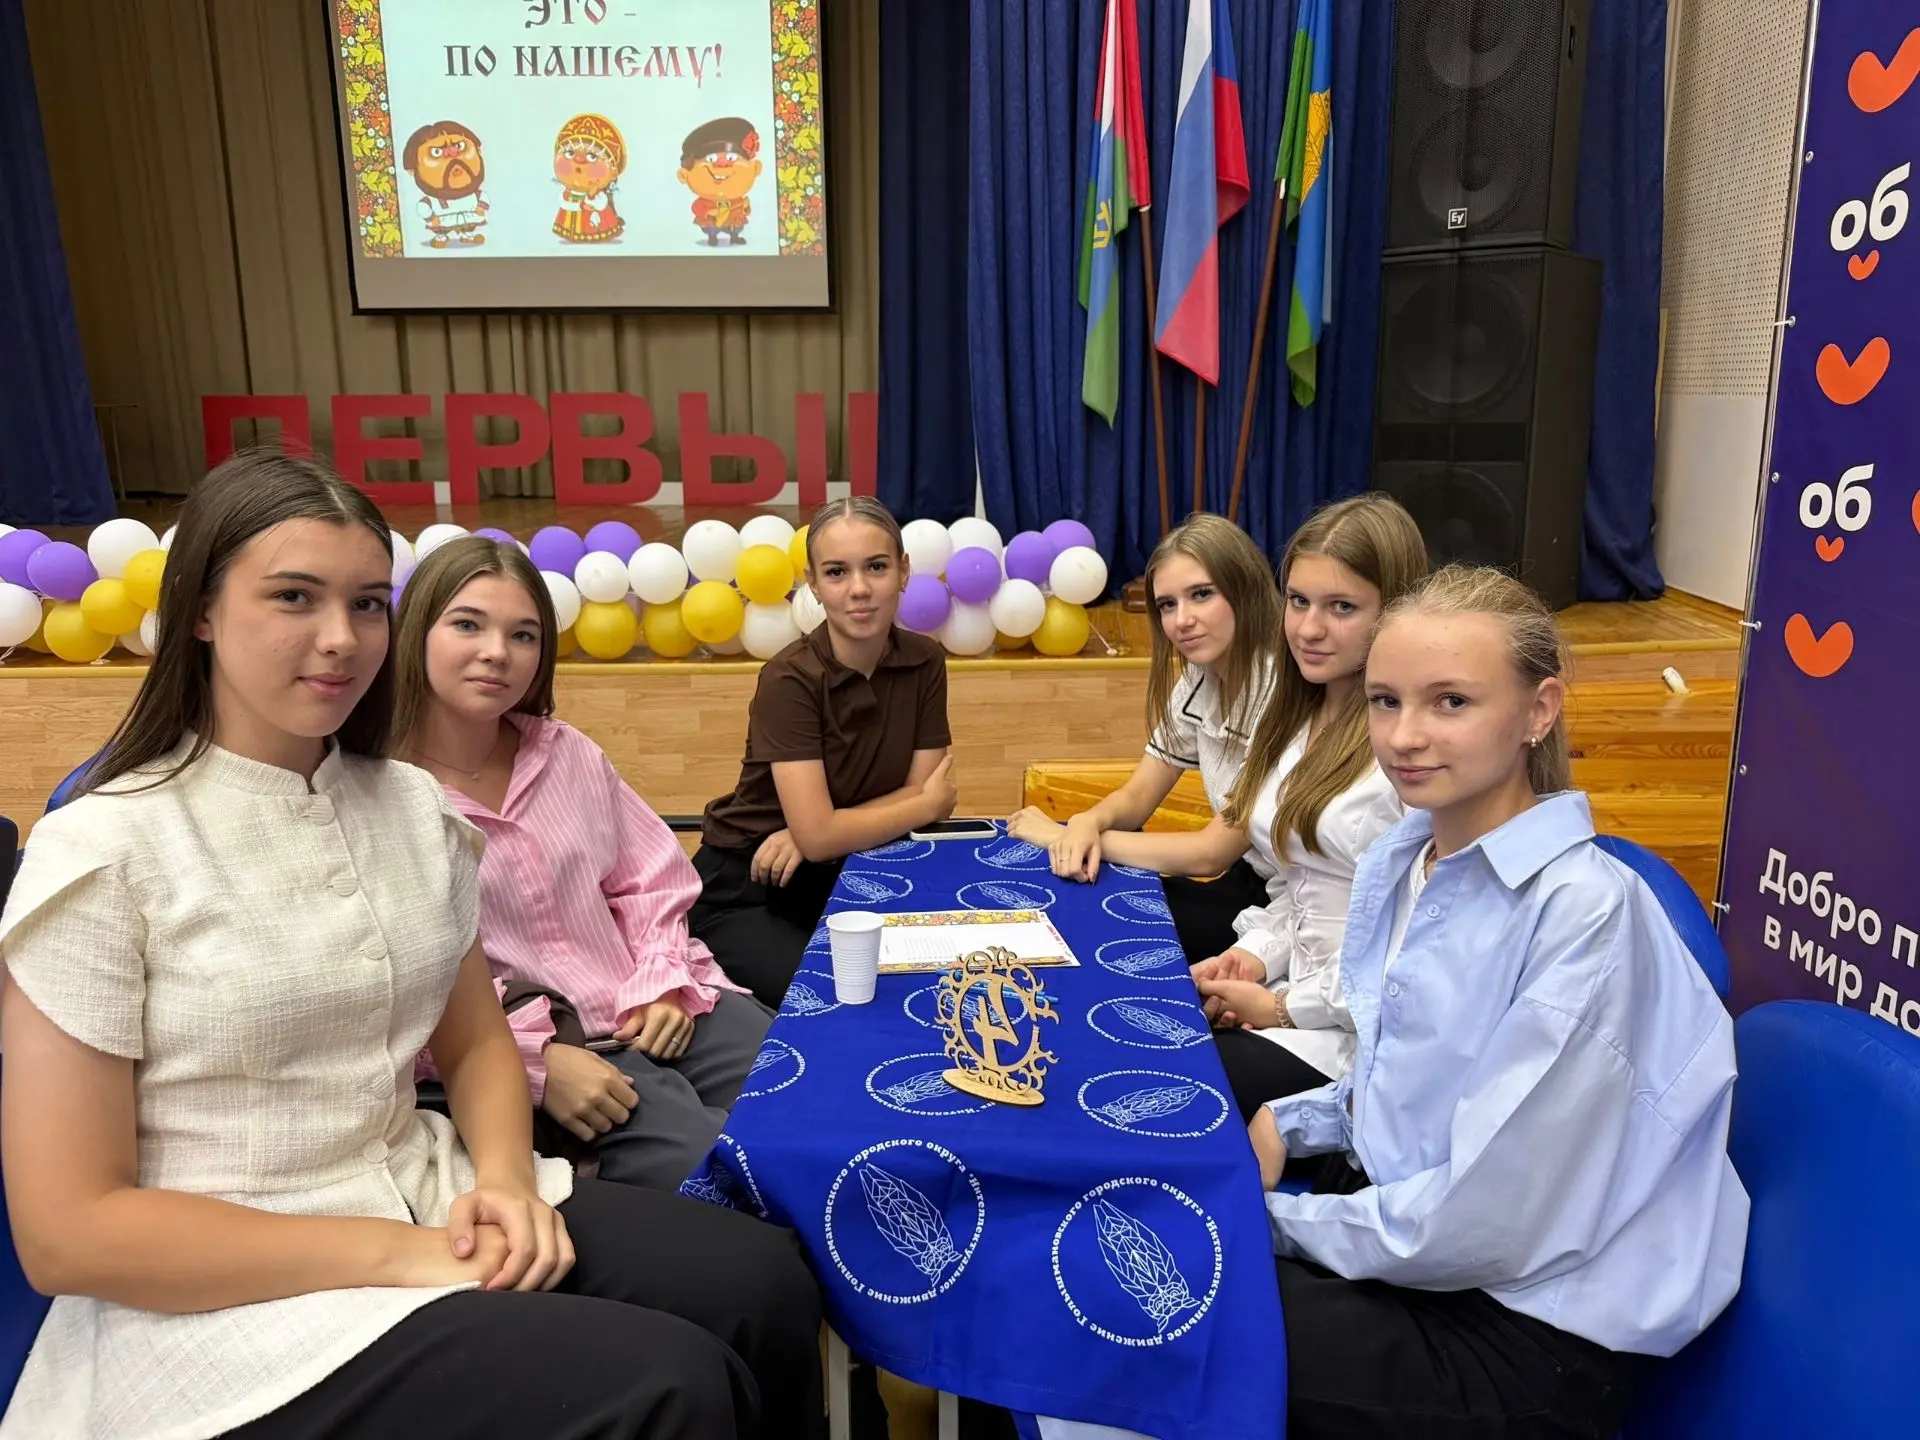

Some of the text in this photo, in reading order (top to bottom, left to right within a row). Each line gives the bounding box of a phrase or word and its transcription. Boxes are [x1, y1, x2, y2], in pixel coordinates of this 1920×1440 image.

[201, 392, 879, 505] ПЕРВЫ
[1759, 847, 1920, 968] Добро п
[1764, 914, 1782, 952] в
[1789, 930, 1863, 1006] мир
[926, 1142, 965, 1172] округа
[1083, 1177, 1157, 1201] городского
[1162, 1183, 1203, 1216] округа
